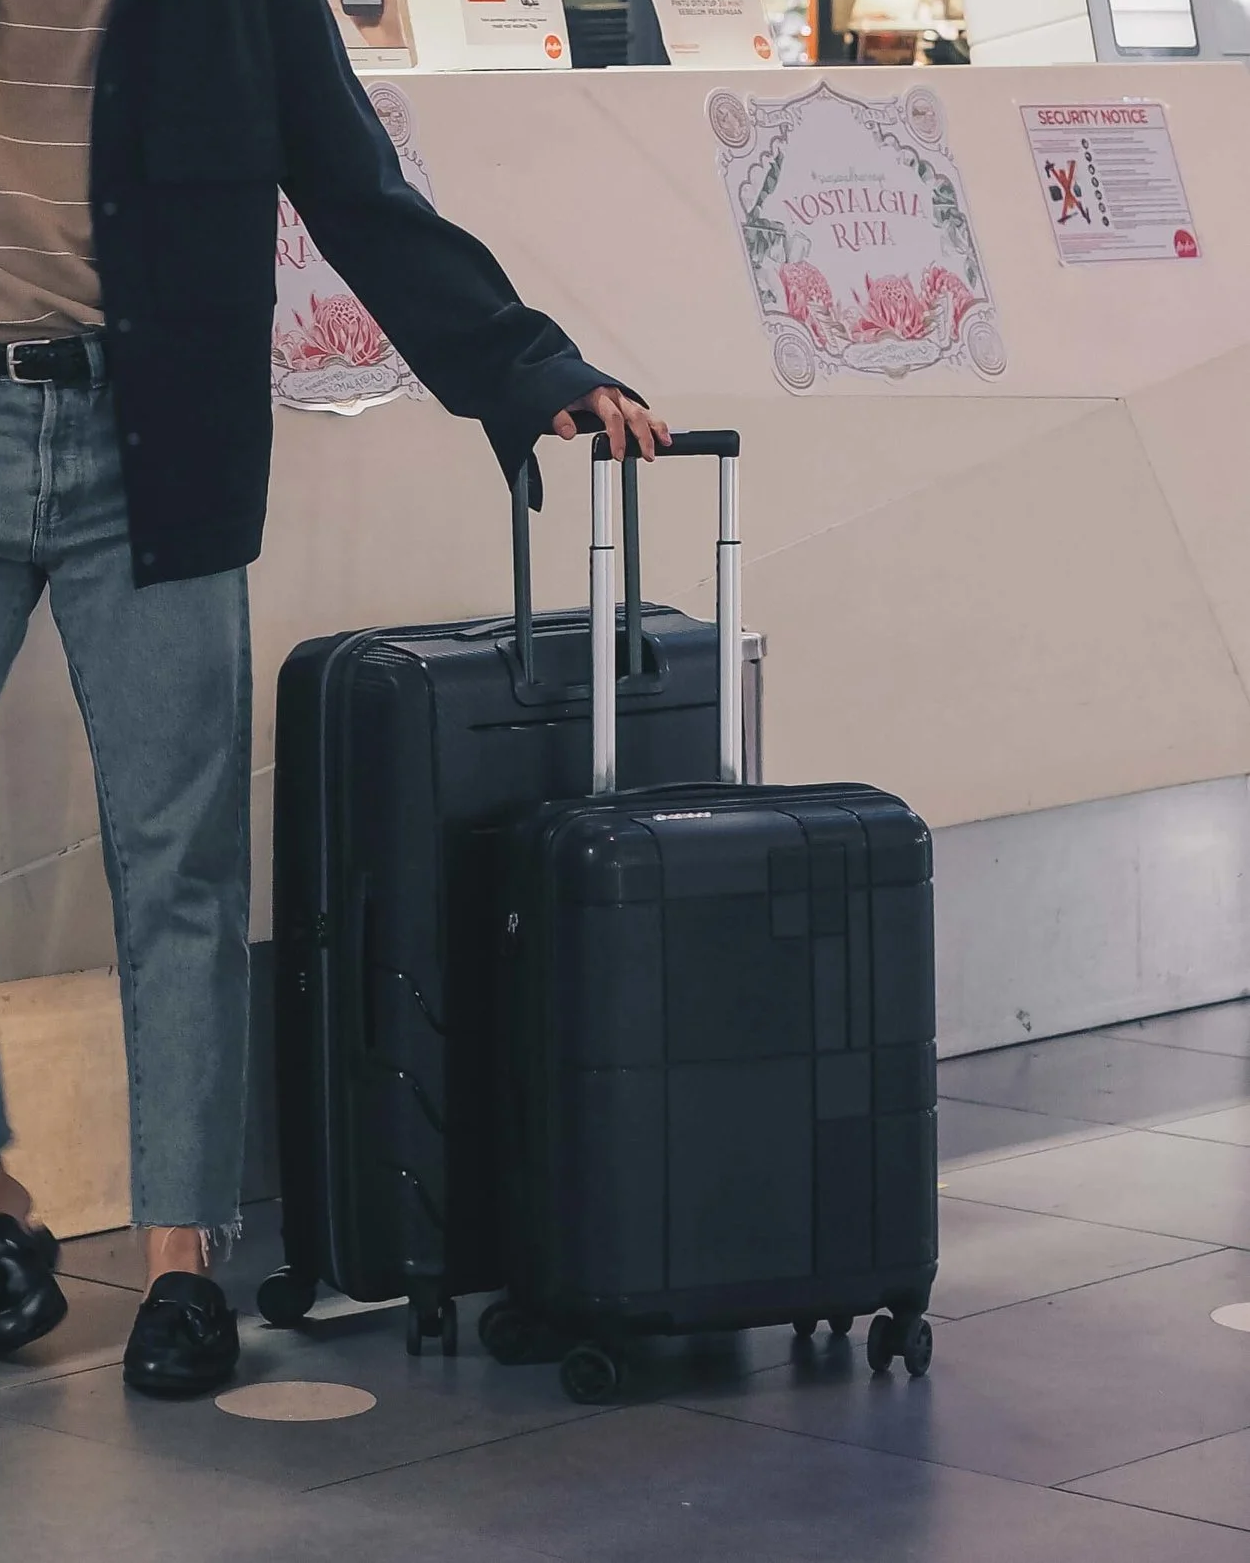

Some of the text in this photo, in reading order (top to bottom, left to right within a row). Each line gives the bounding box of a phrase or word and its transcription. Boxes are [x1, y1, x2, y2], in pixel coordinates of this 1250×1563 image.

[1038, 109, 1149, 125] SECURITY NOTICE
[782, 187, 928, 226] NOSTALGIA
[831, 221, 897, 252] RAYA
